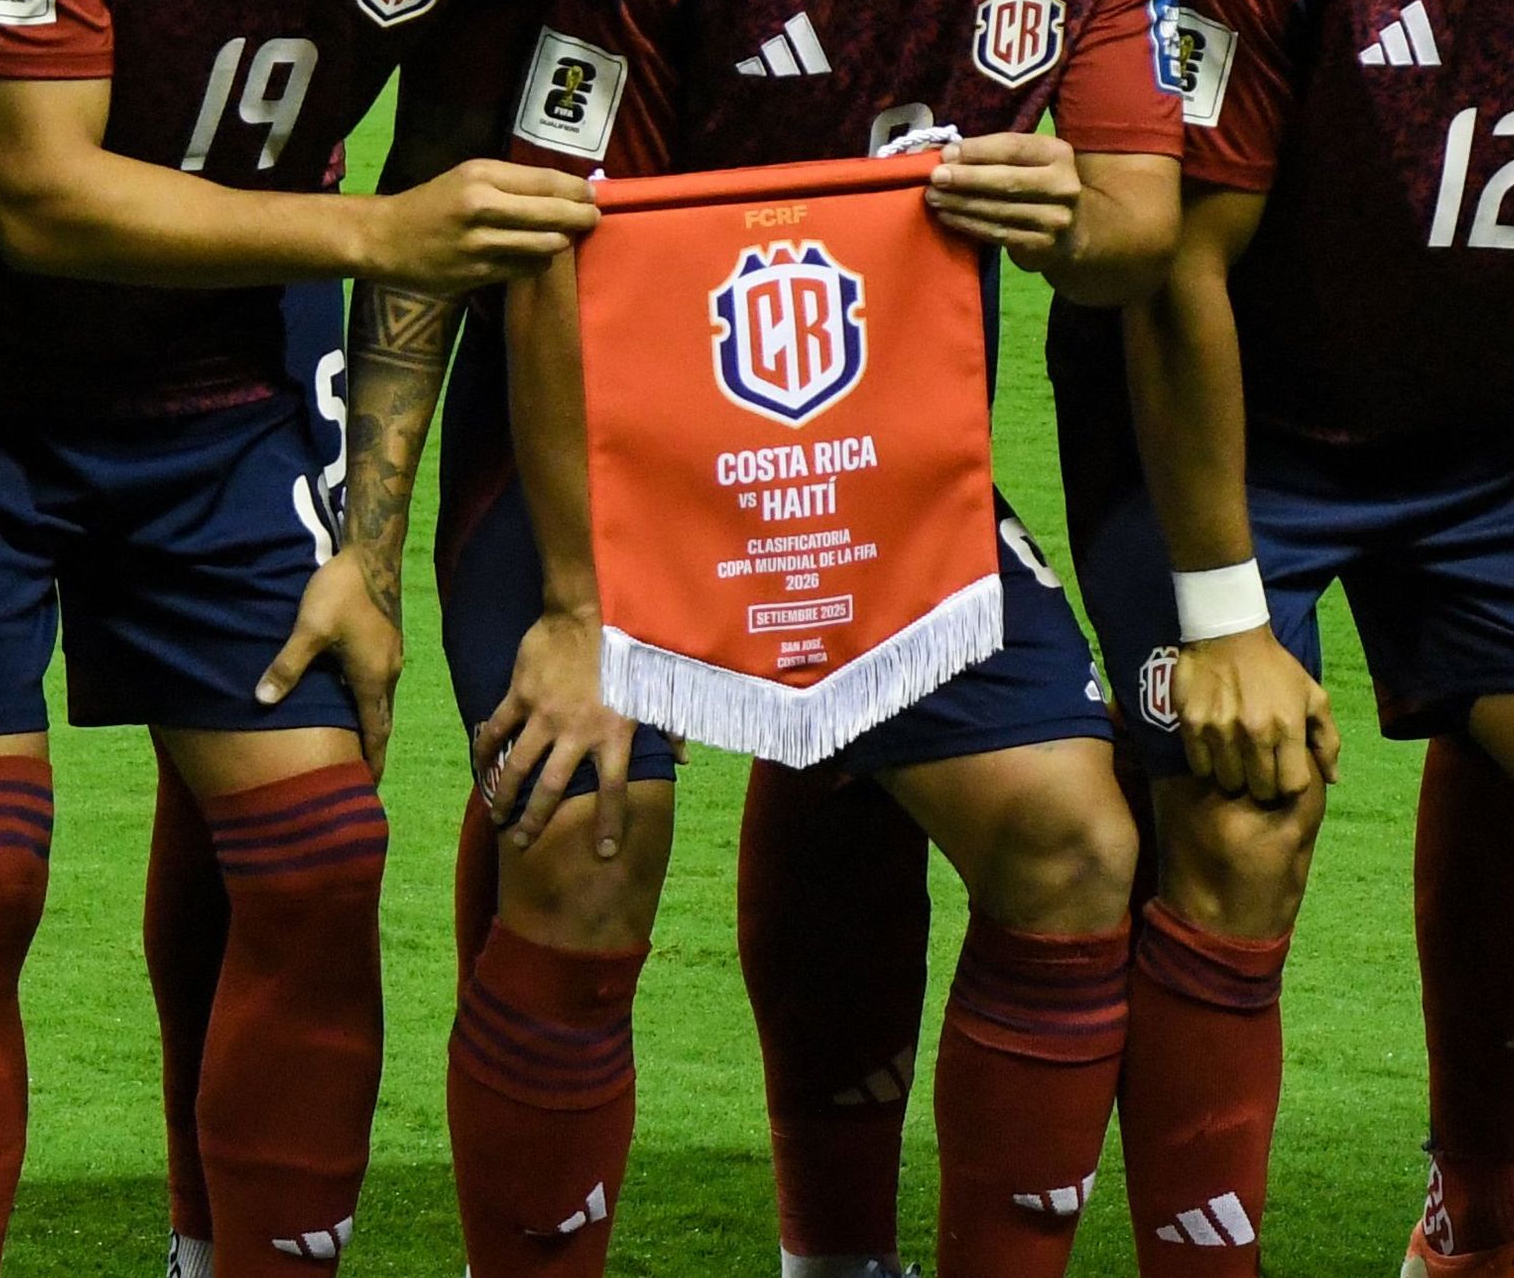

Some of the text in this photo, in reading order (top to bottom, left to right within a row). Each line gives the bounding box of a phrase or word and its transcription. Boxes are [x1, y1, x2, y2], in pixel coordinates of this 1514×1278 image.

[993, 1, 1043, 65] CR
[180, 37, 318, 171] 19
[744, 205, 808, 229] FCRF
[746, 277, 833, 392] CR
[717, 435, 878, 486] COSTA RICA
[762, 476, 837, 521] HAITÍ
[747, 528, 852, 555] CLASIFICATORIA
[717, 543, 878, 579] COPA MUNDIAL DE LA FIFA
[785, 572, 820, 591] 2026
[756, 603, 846, 626] SETIEMBRE 2025
[777, 654, 806, 669] COSTA
[780, 640, 801, 653] SAN
